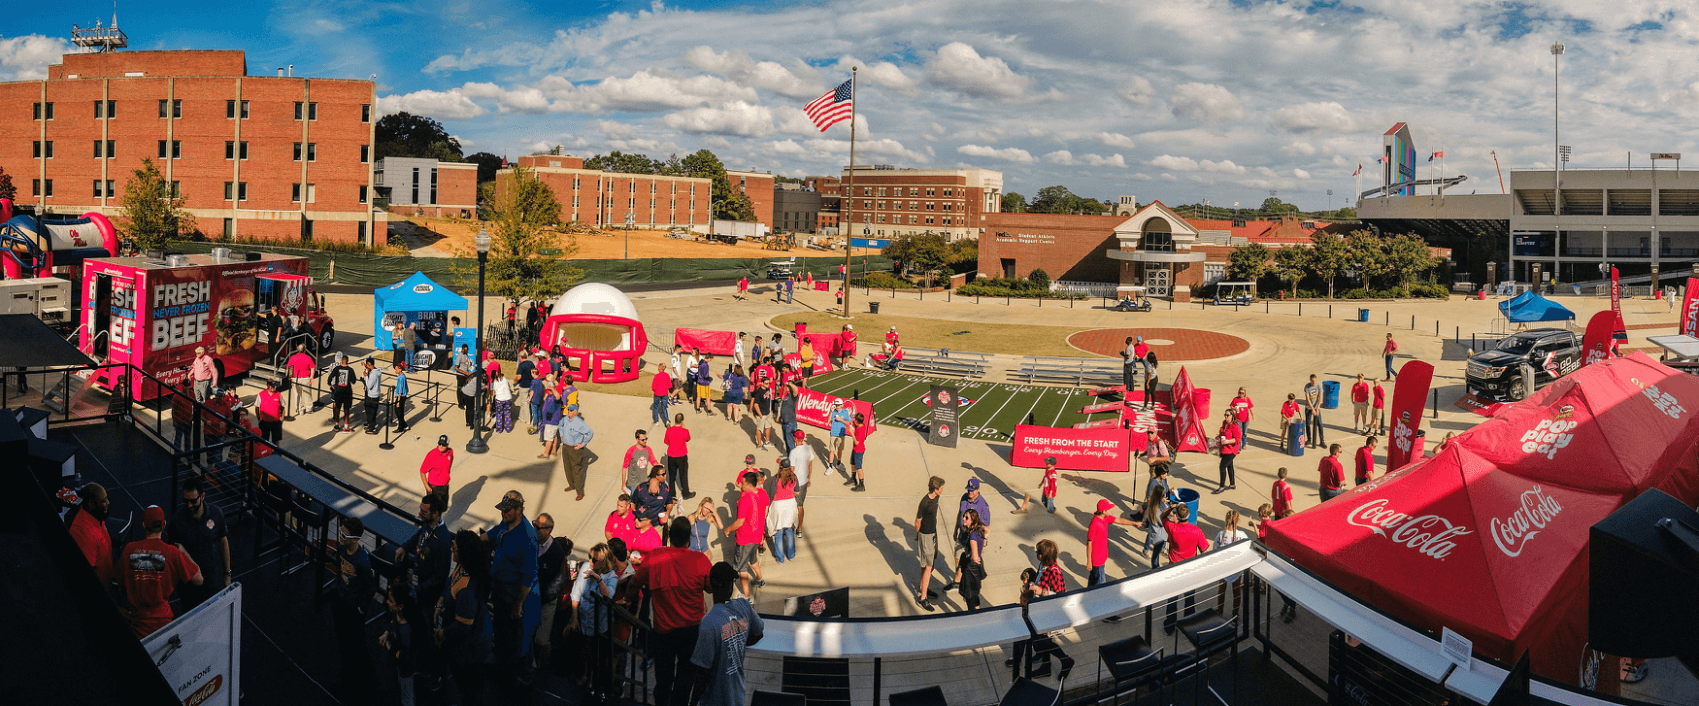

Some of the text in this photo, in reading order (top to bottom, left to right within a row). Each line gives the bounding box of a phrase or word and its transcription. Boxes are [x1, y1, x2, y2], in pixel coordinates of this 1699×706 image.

[154, 280, 211, 308] FRESH
[153, 301, 210, 319] NEVER FROZEN
[152, 312, 211, 351] BEEF
[1560, 356, 1572, 370] GO
[1561, 358, 1581, 375] REBE
[1467, 399, 1489, 409] TITAN
[1535, 419, 1578, 433] pop
[1024, 437, 1050, 445] FRESH
[1051, 438, 1075, 447] FROM
[1093, 440, 1119, 448] START
[1520, 429, 1574, 448] play
[1023, 446, 1043, 455] Every
[1083, 449, 1102, 458] Every
[1521, 442, 1558, 460] eat
[1347, 498, 1475, 559] Coca-Cola
[1490, 484, 1563, 557] Coca-Cola
[178, 664, 211, 694] FAN ZONE
